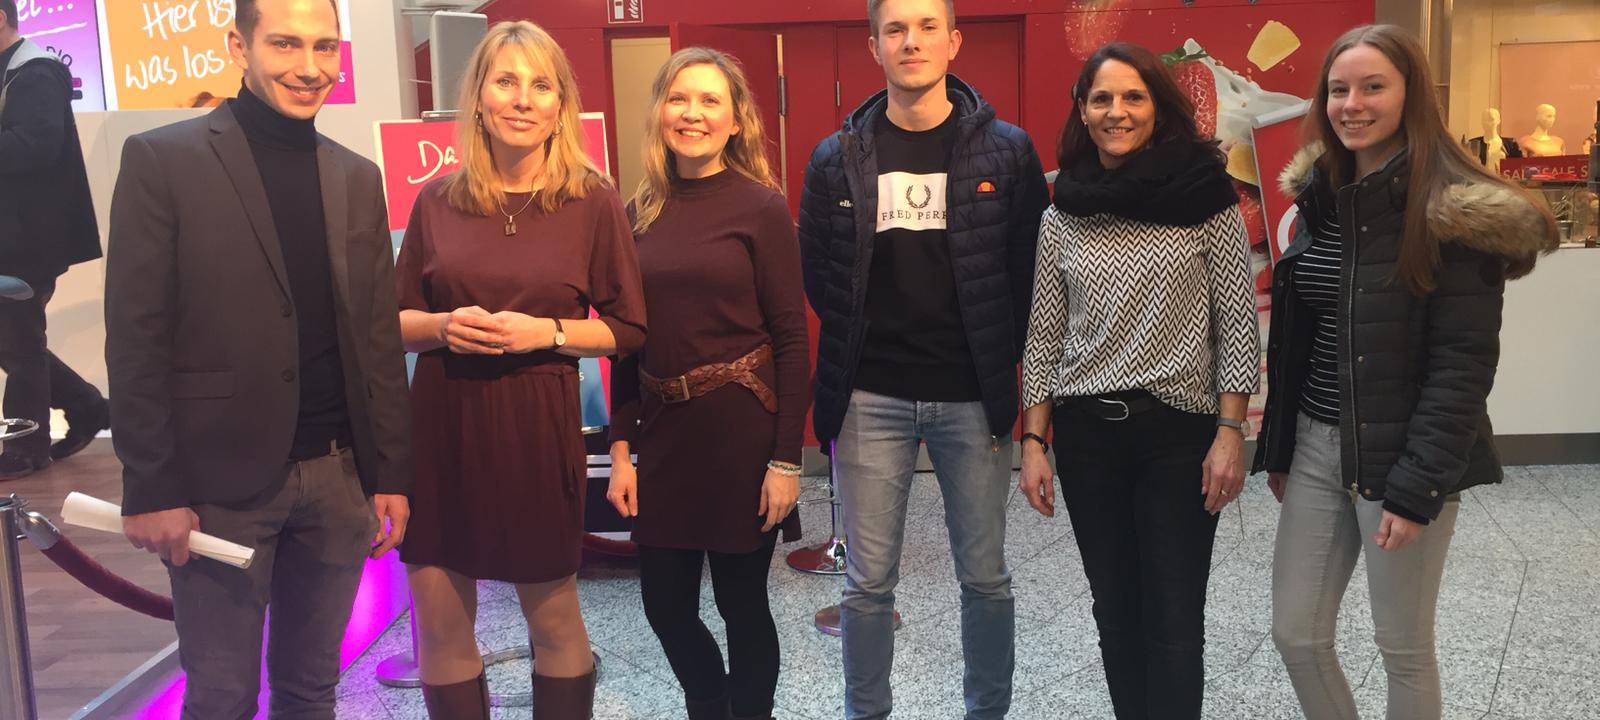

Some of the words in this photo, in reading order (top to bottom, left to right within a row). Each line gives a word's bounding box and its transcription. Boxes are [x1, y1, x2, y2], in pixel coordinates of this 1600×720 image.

[142, 0, 200, 41] Hier
[125, 55, 178, 90] was
[881, 209, 912, 221] FRED
